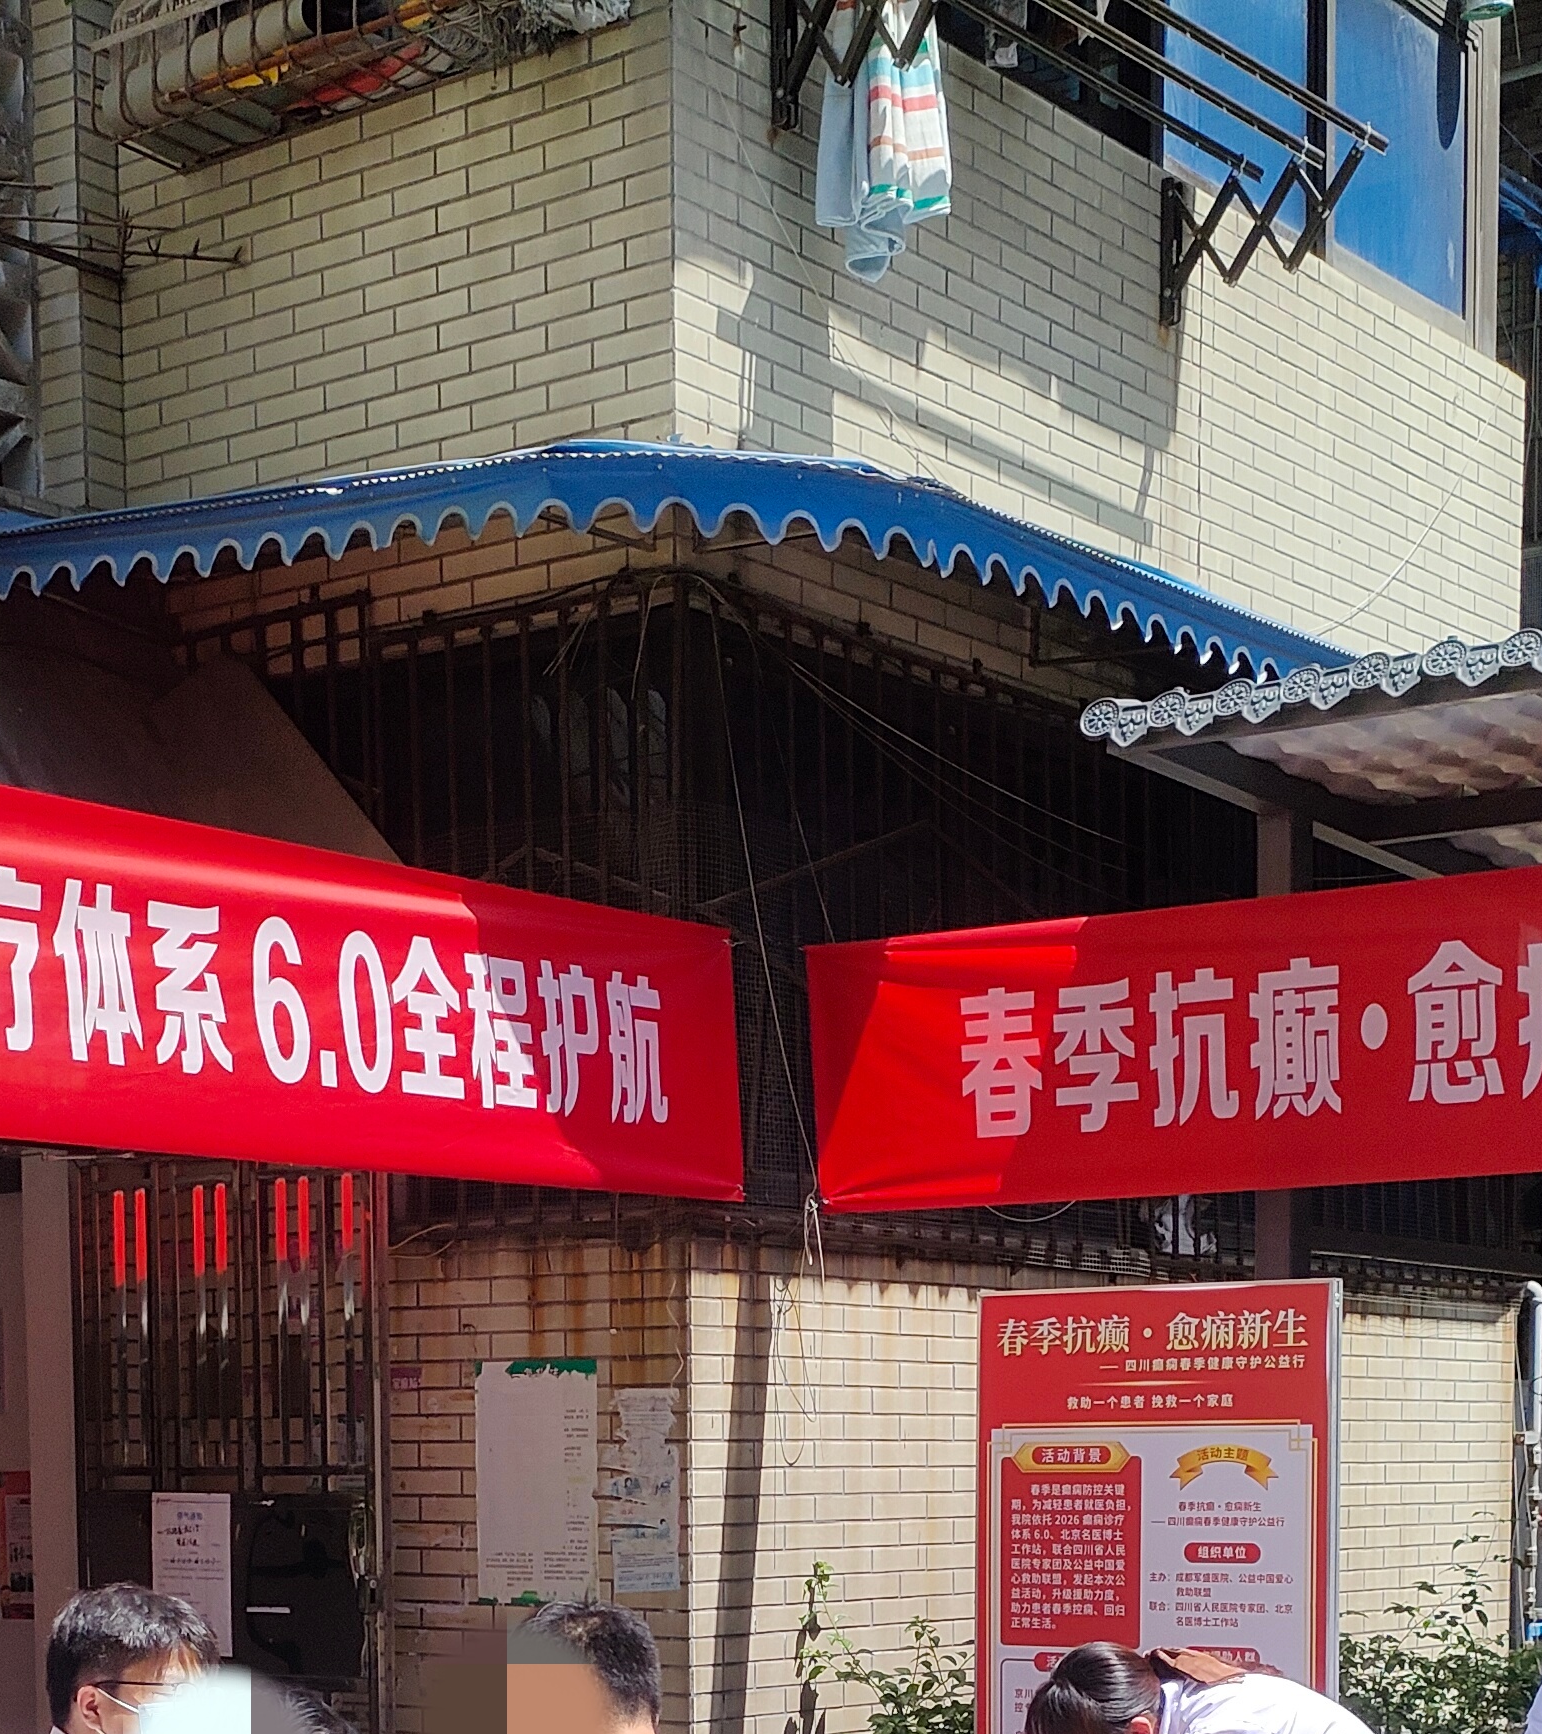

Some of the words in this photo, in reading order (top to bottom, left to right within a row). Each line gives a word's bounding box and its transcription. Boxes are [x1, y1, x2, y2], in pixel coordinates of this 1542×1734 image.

[1066, 1396, 1146, 1410] 救助一个患者
[1151, 1394, 1234, 1408] 挽救一个家庭
[1041, 1447, 1102, 1463] 活动背景
[1197, 1446, 1250, 1461] 活动主题
[1010, 1514, 1053, 1526] 我院依托
[1054, 1515, 1080, 1526] 2026
[1010, 1529, 1031, 1541] 体系
[1010, 1543, 1126, 1556] 工作站，联合四川省人民
[1197, 1545, 1247, 1560] 组织单位
[1010, 1558, 1126, 1571] 医院专家团及公益中国爱
[1176, 1587, 1212, 1598] 救助联盟
[1010, 1617, 1057, 1630] 正常生活。
[1176, 1616, 1239, 1628] 名医博士工作站
